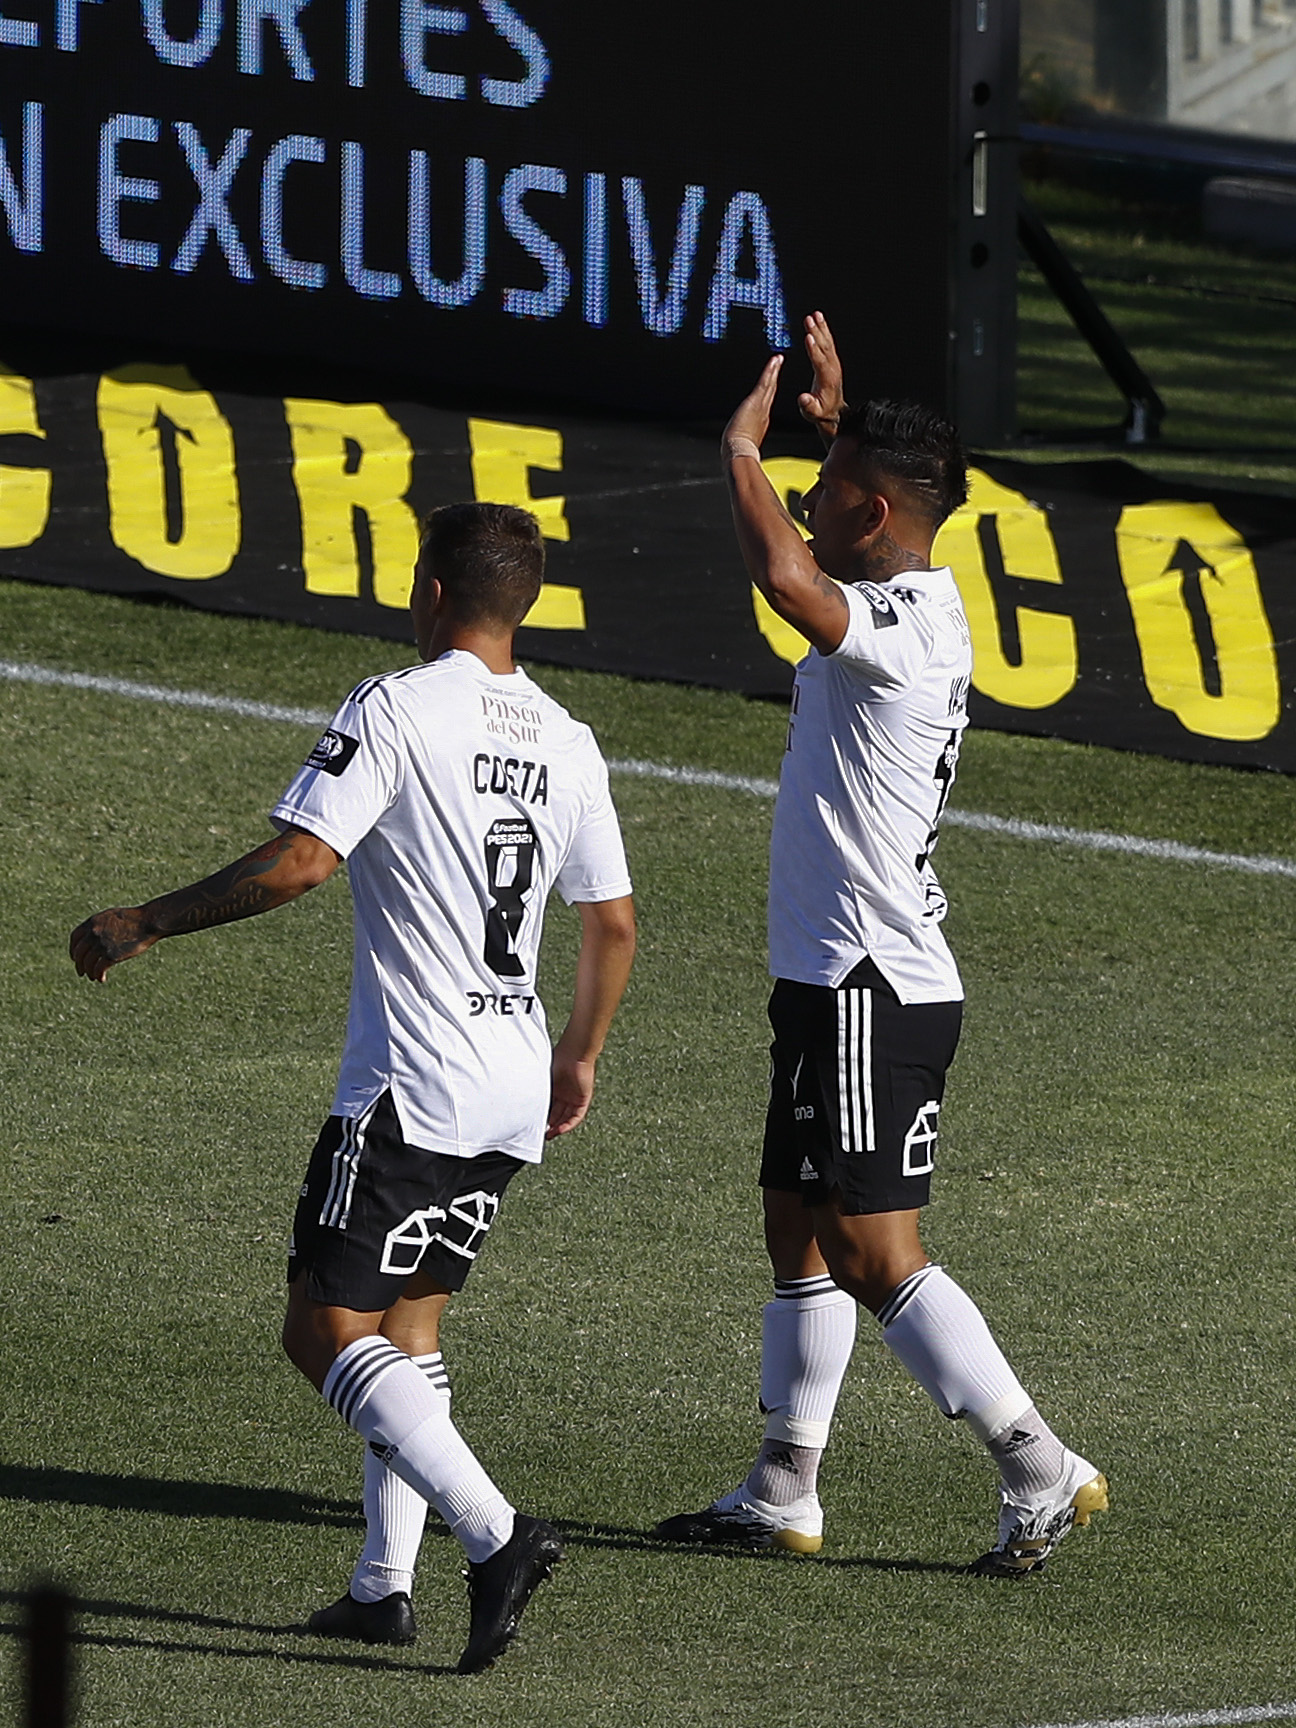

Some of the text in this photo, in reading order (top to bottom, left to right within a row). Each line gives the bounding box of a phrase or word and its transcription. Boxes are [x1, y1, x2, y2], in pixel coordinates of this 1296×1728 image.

[97, 112, 791, 351] EXCLUSIVA
[480, 694, 542, 726] Pilsen
[486, 719, 541, 744] del Sur
[473, 753, 549, 806] COSTA
[482, 818, 541, 983] 8
